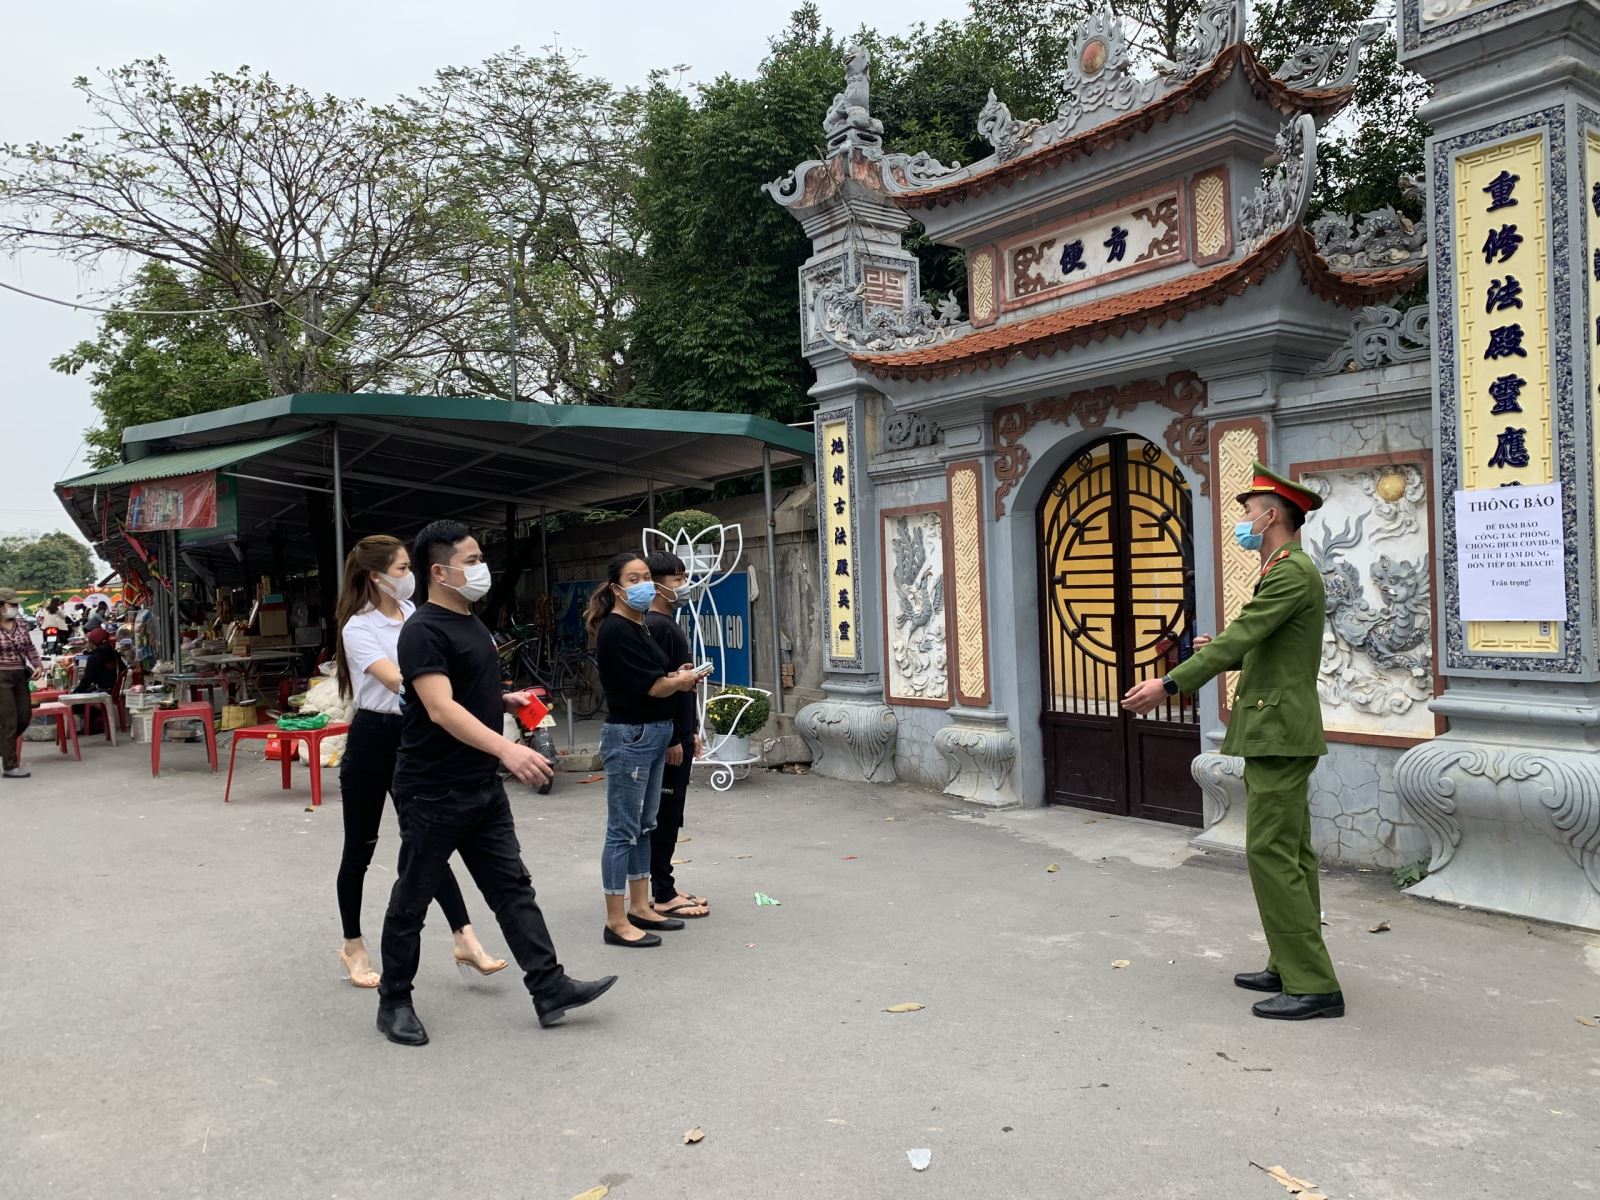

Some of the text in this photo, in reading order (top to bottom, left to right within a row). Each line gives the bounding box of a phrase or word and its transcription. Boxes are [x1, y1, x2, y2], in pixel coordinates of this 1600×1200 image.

[1482, 170, 1529, 491] 重修法殿靈應
[1468, 494, 1554, 512] THÔNG BÁO
[1474, 533, 1499, 541] CÔNG
[1497, 541, 1518, 549] DỊCH
